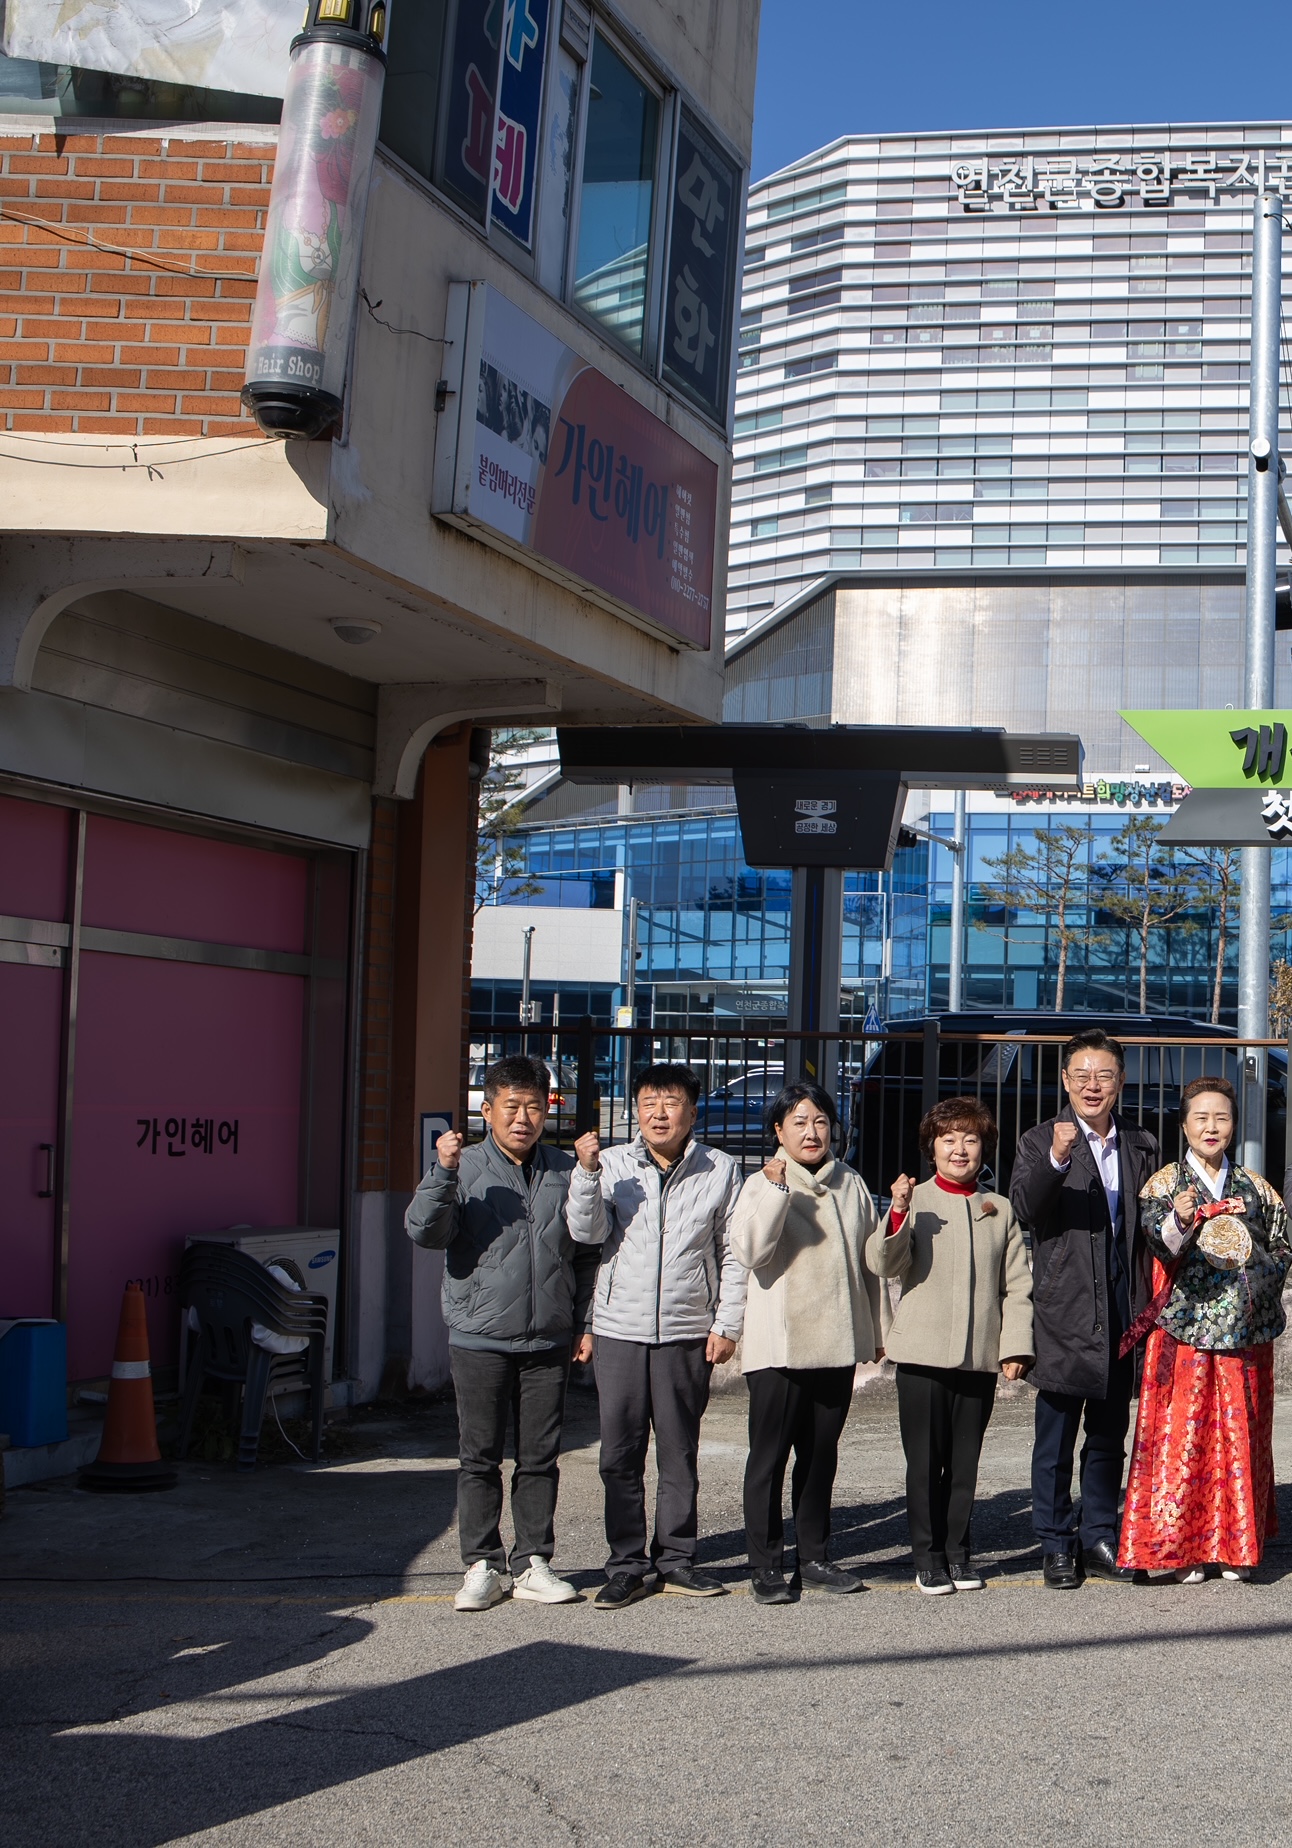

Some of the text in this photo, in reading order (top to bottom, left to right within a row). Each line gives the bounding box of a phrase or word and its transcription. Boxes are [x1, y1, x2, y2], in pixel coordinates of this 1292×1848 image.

[673, 151, 725, 375] 만화
[257, 353, 320, 385] Hair Shop
[478, 453, 538, 516] 붙임머리전문
[555, 417, 669, 560] 가인헤어
[795, 800, 836, 811] 새로운 경기
[796, 822, 836, 833] 공정한 세상
[136, 1117, 239, 1157] 가인헤어
[311, 1254, 333, 1265] SAMSUNG
